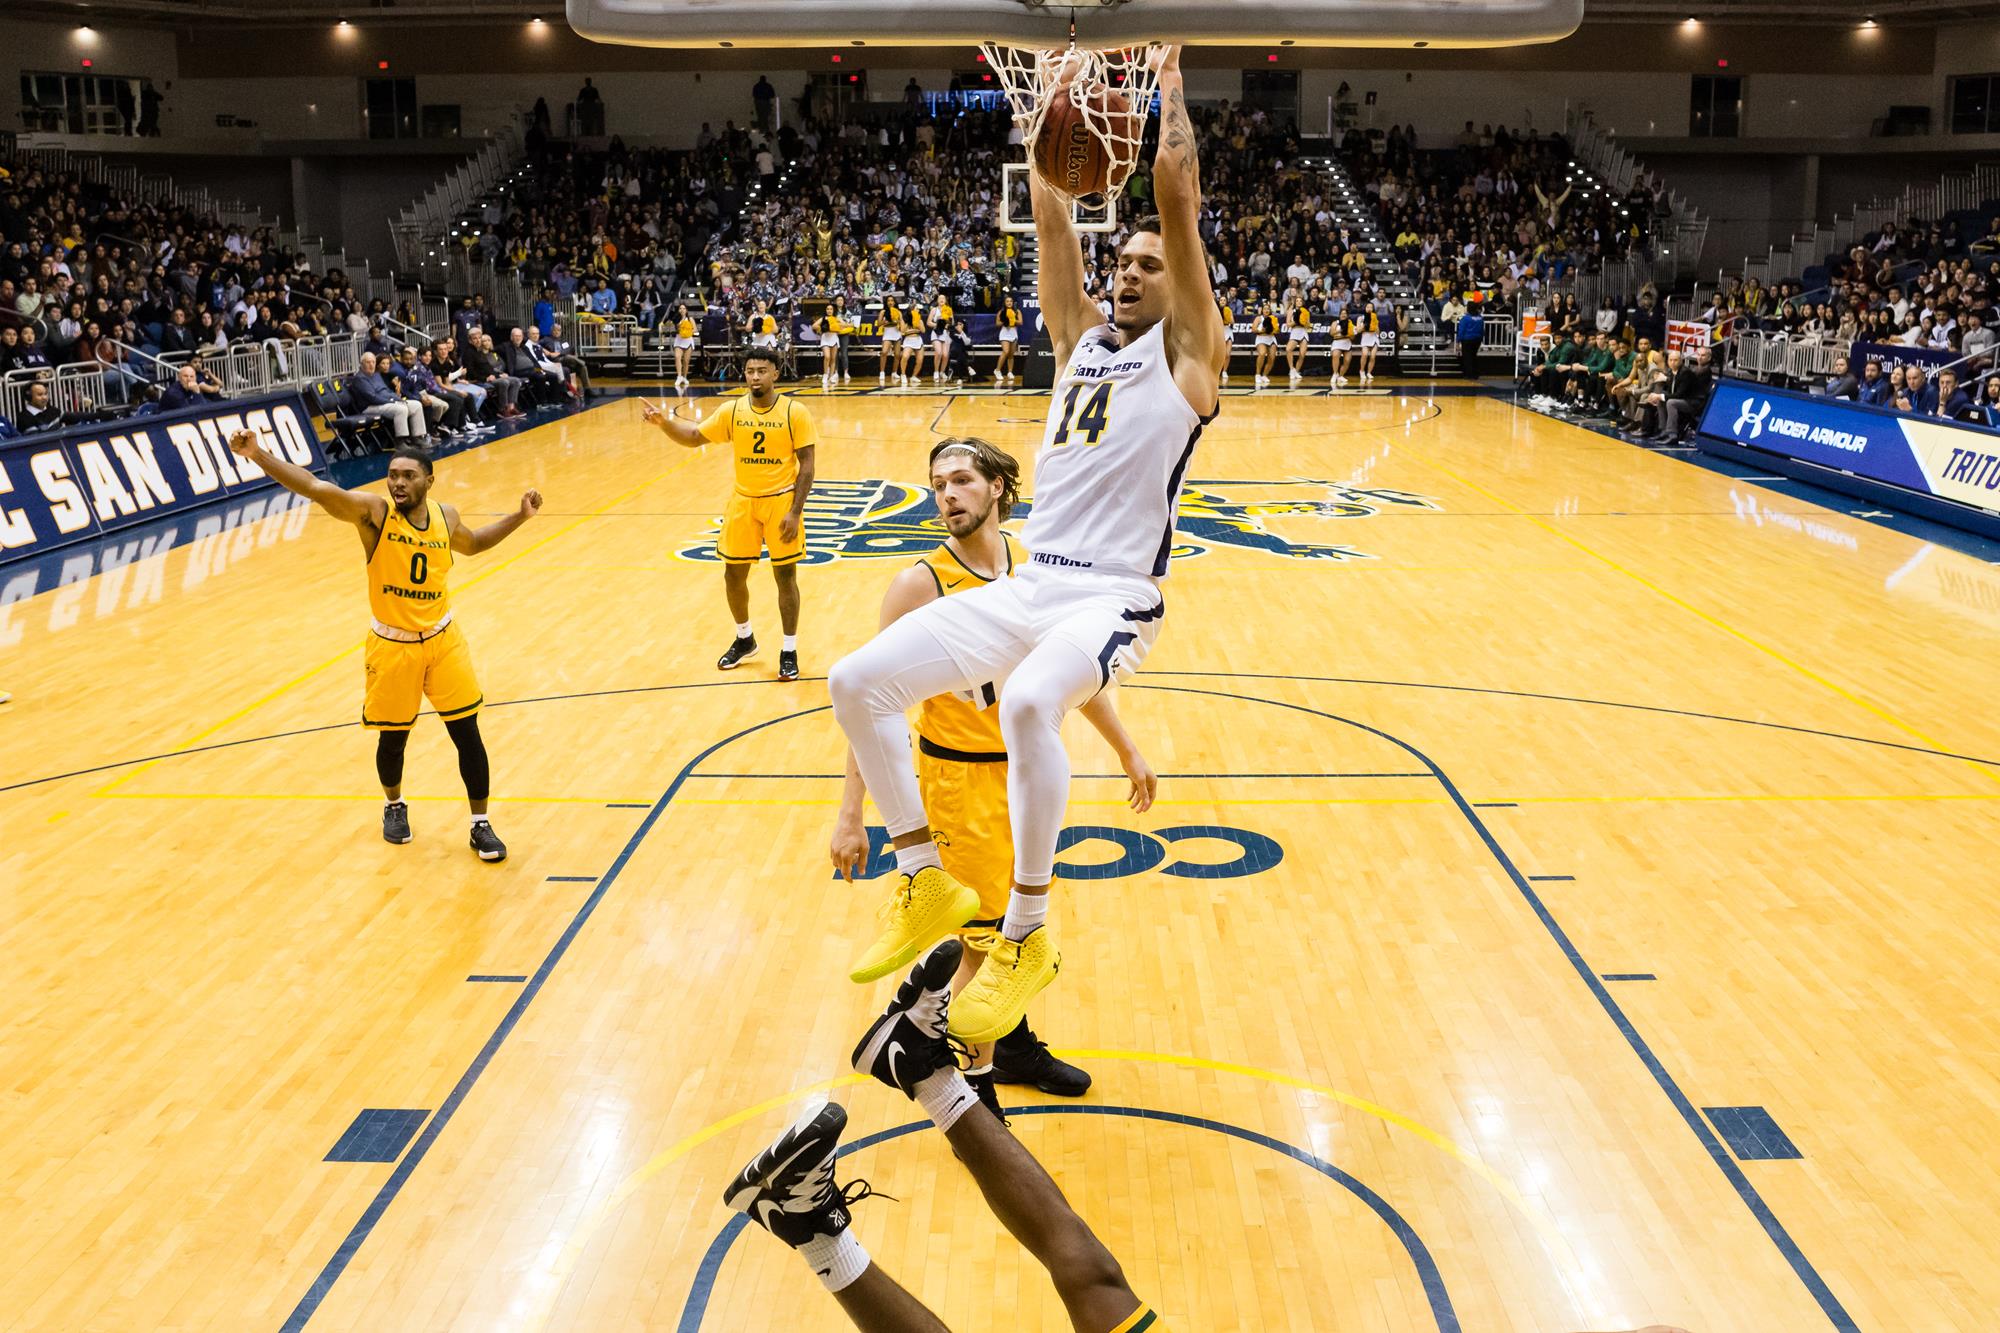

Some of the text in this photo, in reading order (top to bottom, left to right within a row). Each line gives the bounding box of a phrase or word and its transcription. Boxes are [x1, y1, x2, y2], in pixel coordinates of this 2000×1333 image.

[1067, 121, 1090, 187] Wilson
[736, 420, 784, 429] CAL POLY
[1052, 381, 1116, 446] 14
[752, 431, 765, 454] 2
[1768, 416, 1868, 454] UNDER ARMOUR
[30, 431, 176, 535] SAN
[166, 404, 313, 496] DIEGO
[740, 457, 783, 465] POMONA
[387, 532, 417, 546] CAL
[409, 552, 428, 585] 0
